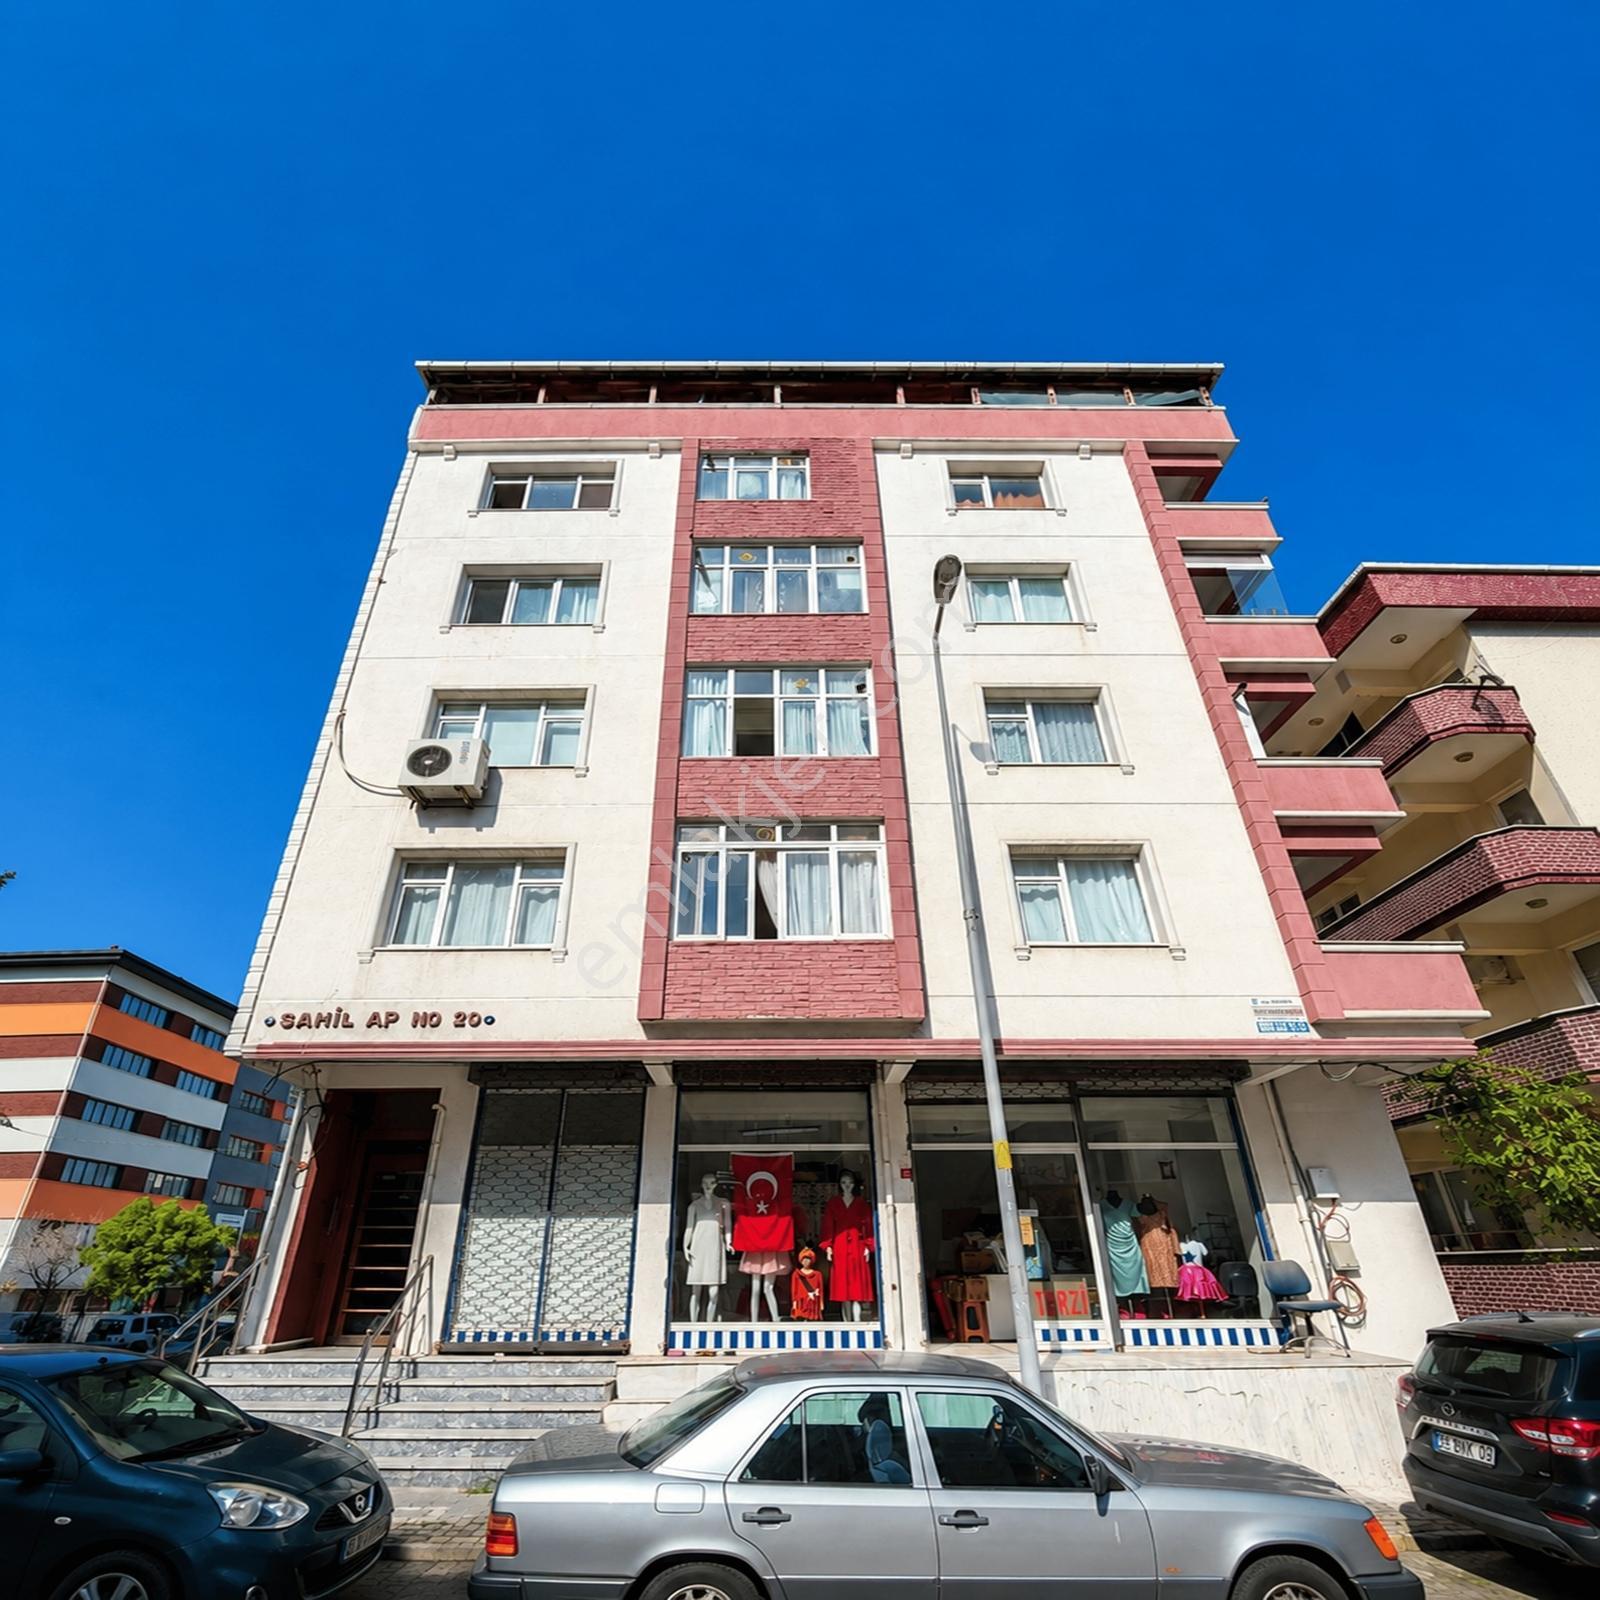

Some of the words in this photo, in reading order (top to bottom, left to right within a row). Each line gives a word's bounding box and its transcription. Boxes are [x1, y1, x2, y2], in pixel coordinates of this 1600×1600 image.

[280, 1006, 354, 1029] SAHİL
[366, 1011, 400, 1029] AP
[411, 1011, 442, 1029] NO
[453, 1011, 482, 1029] 20
[1034, 1281, 1089, 1316] TERZİ
